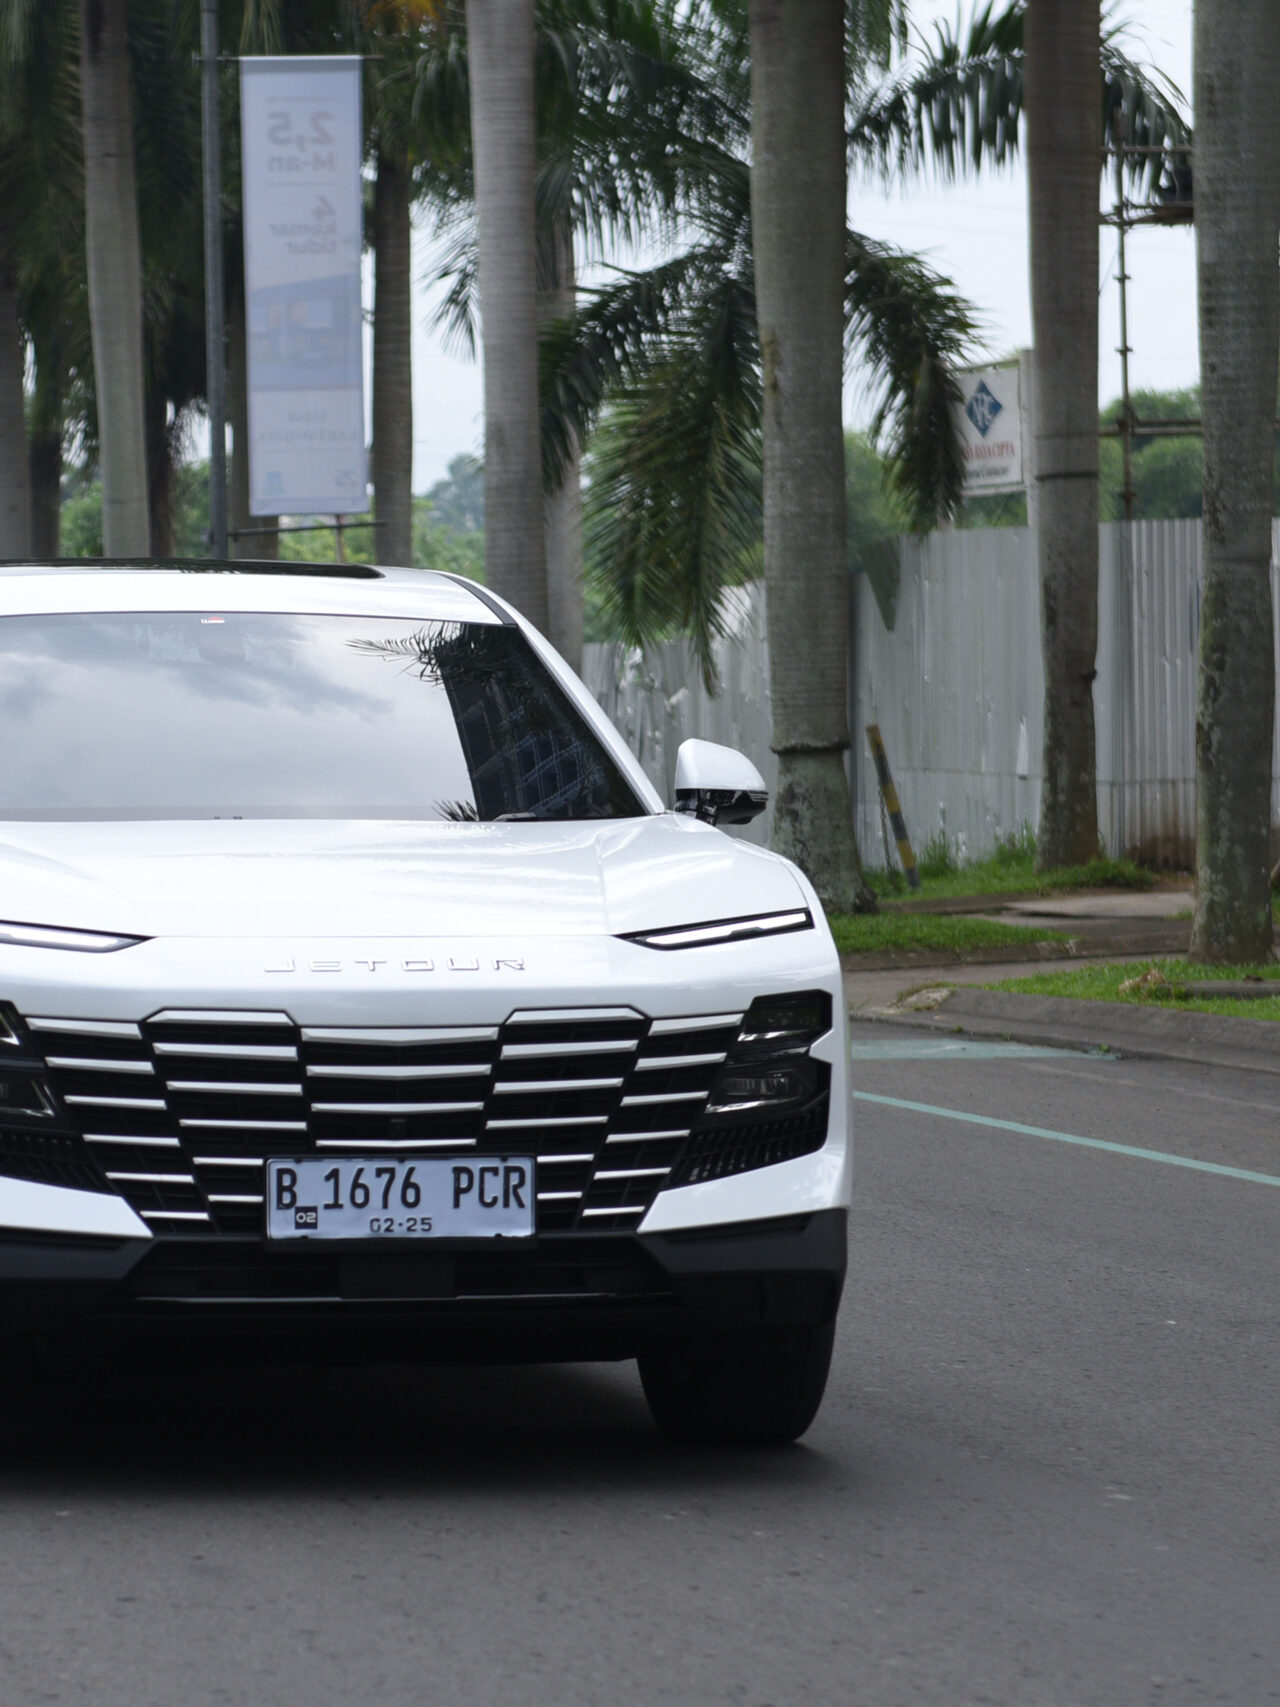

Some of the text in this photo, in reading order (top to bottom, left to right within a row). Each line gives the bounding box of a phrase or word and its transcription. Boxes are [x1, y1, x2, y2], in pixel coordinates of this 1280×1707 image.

[264, 957, 526, 972] JETOUR
[276, 1165, 526, 1210] B 1676 PCR
[296, 1211, 317, 1223] 02
